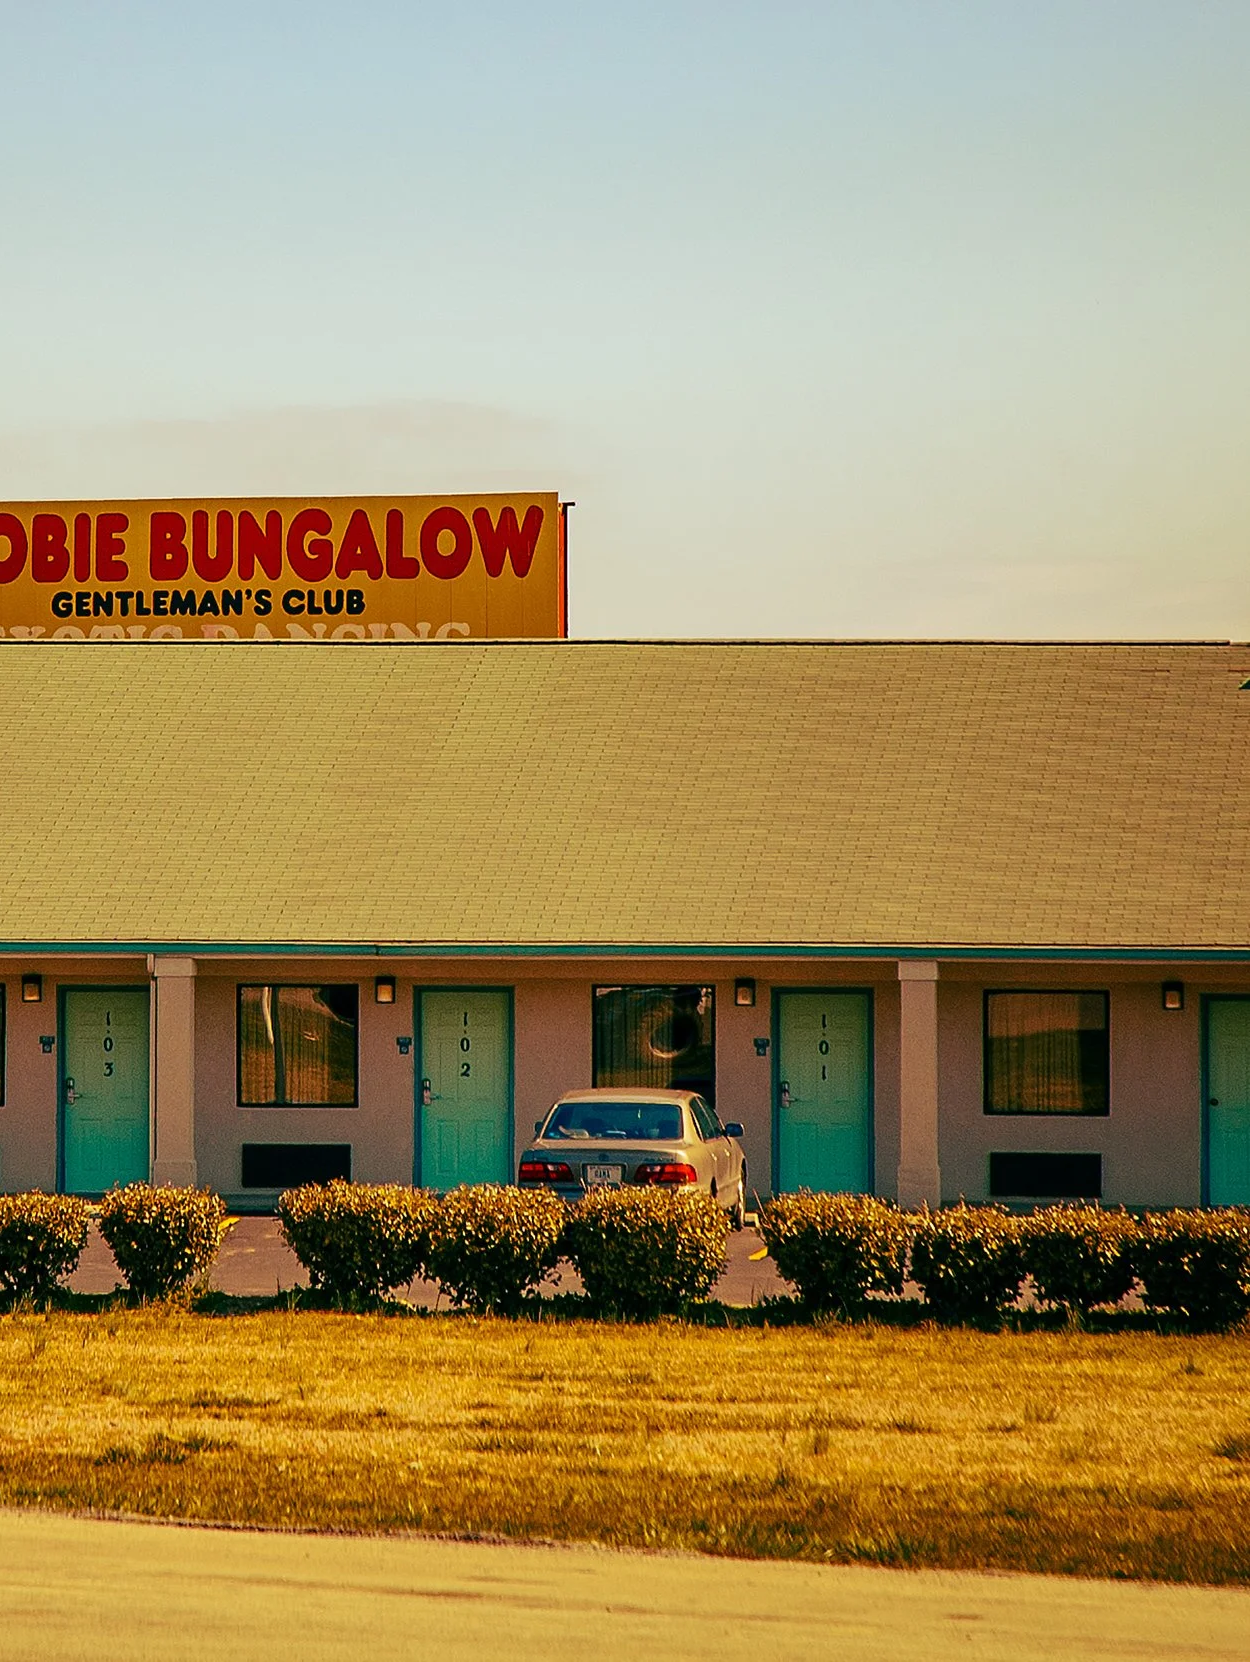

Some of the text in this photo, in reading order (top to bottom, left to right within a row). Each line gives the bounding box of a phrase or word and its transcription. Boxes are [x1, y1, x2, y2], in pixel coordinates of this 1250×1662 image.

[148, 505, 544, 581] BUNGALOW
[51, 588, 365, 618] GENTLEMAN'S CLUB
[103, 1011, 114, 1077] 103
[460, 1012, 470, 1078] 102
[819, 1014, 829, 1080] 101
